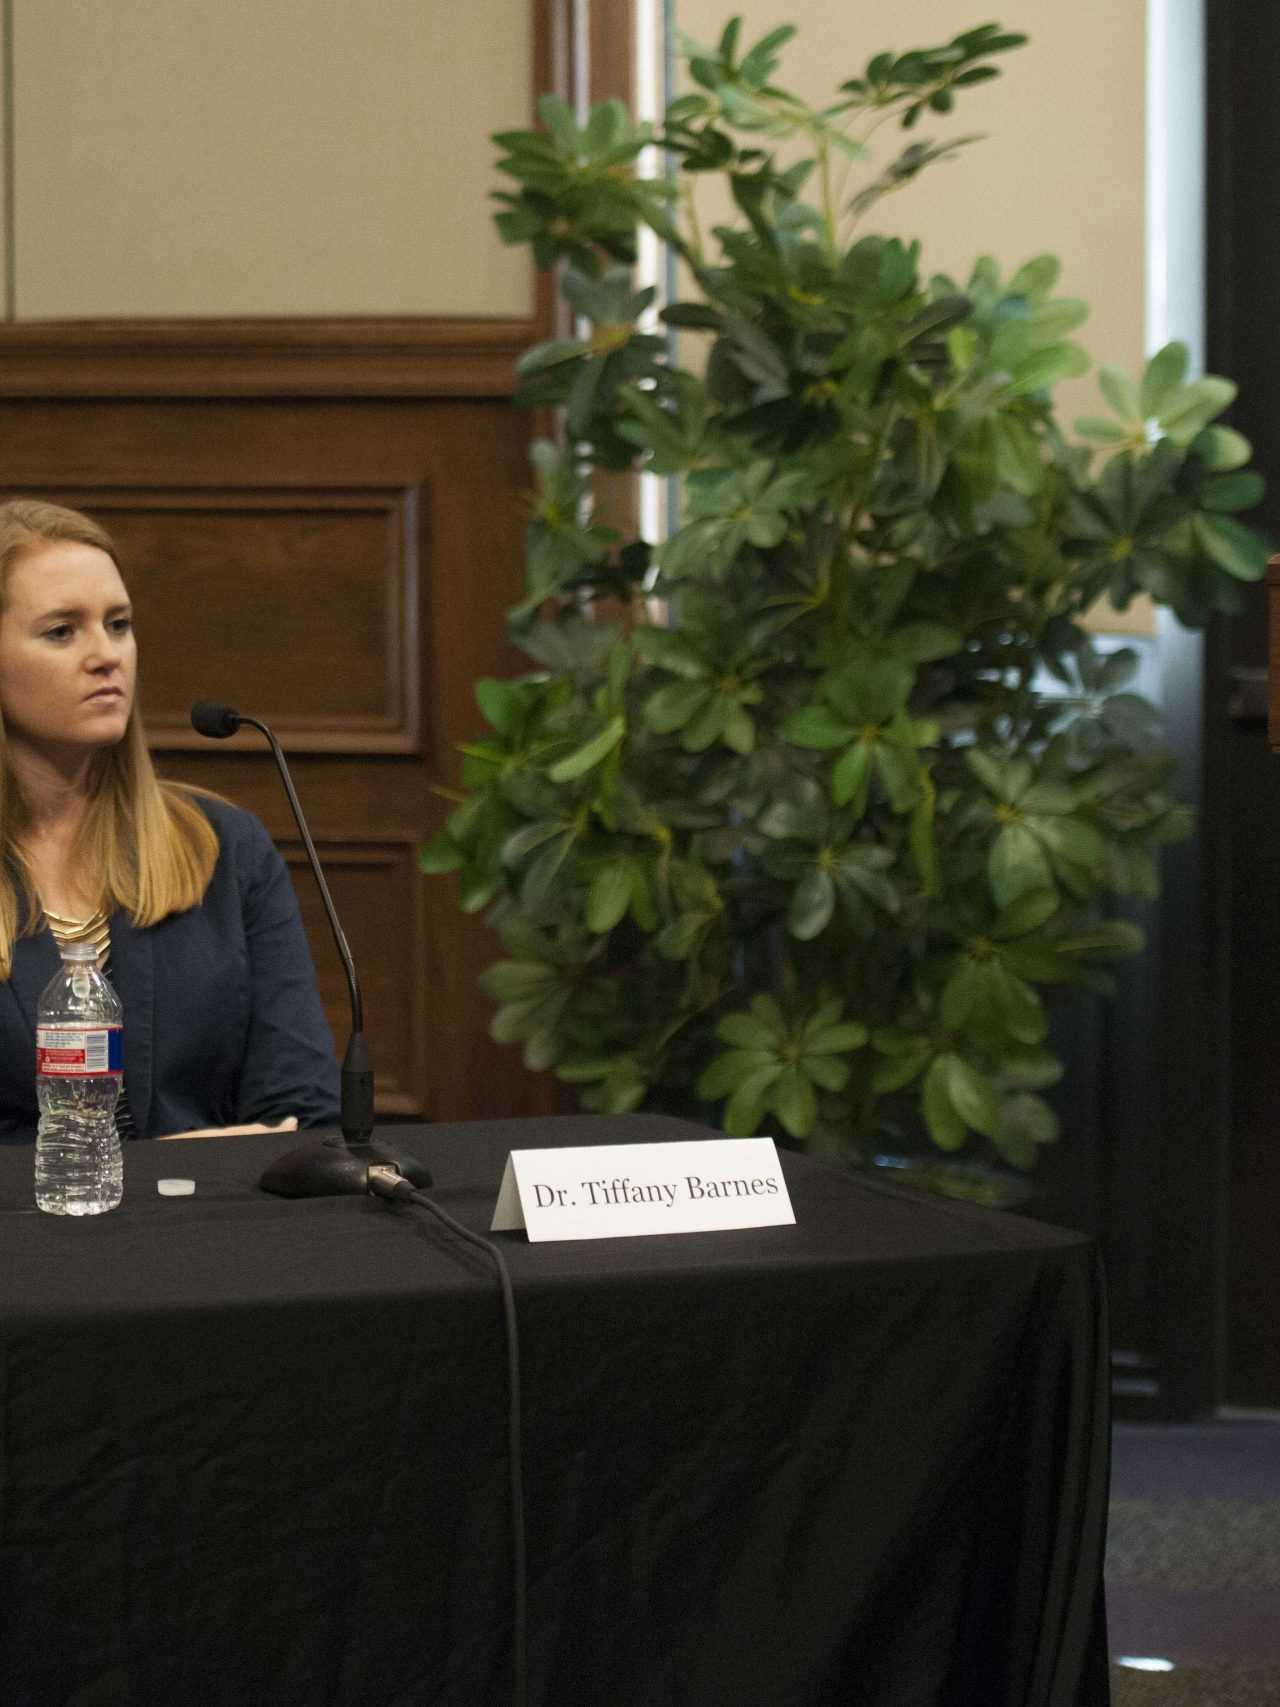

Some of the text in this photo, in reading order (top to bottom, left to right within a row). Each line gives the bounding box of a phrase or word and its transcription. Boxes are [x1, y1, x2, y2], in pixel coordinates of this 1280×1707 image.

[533, 1175, 779, 1208] Dr. Tiffany Barnes
